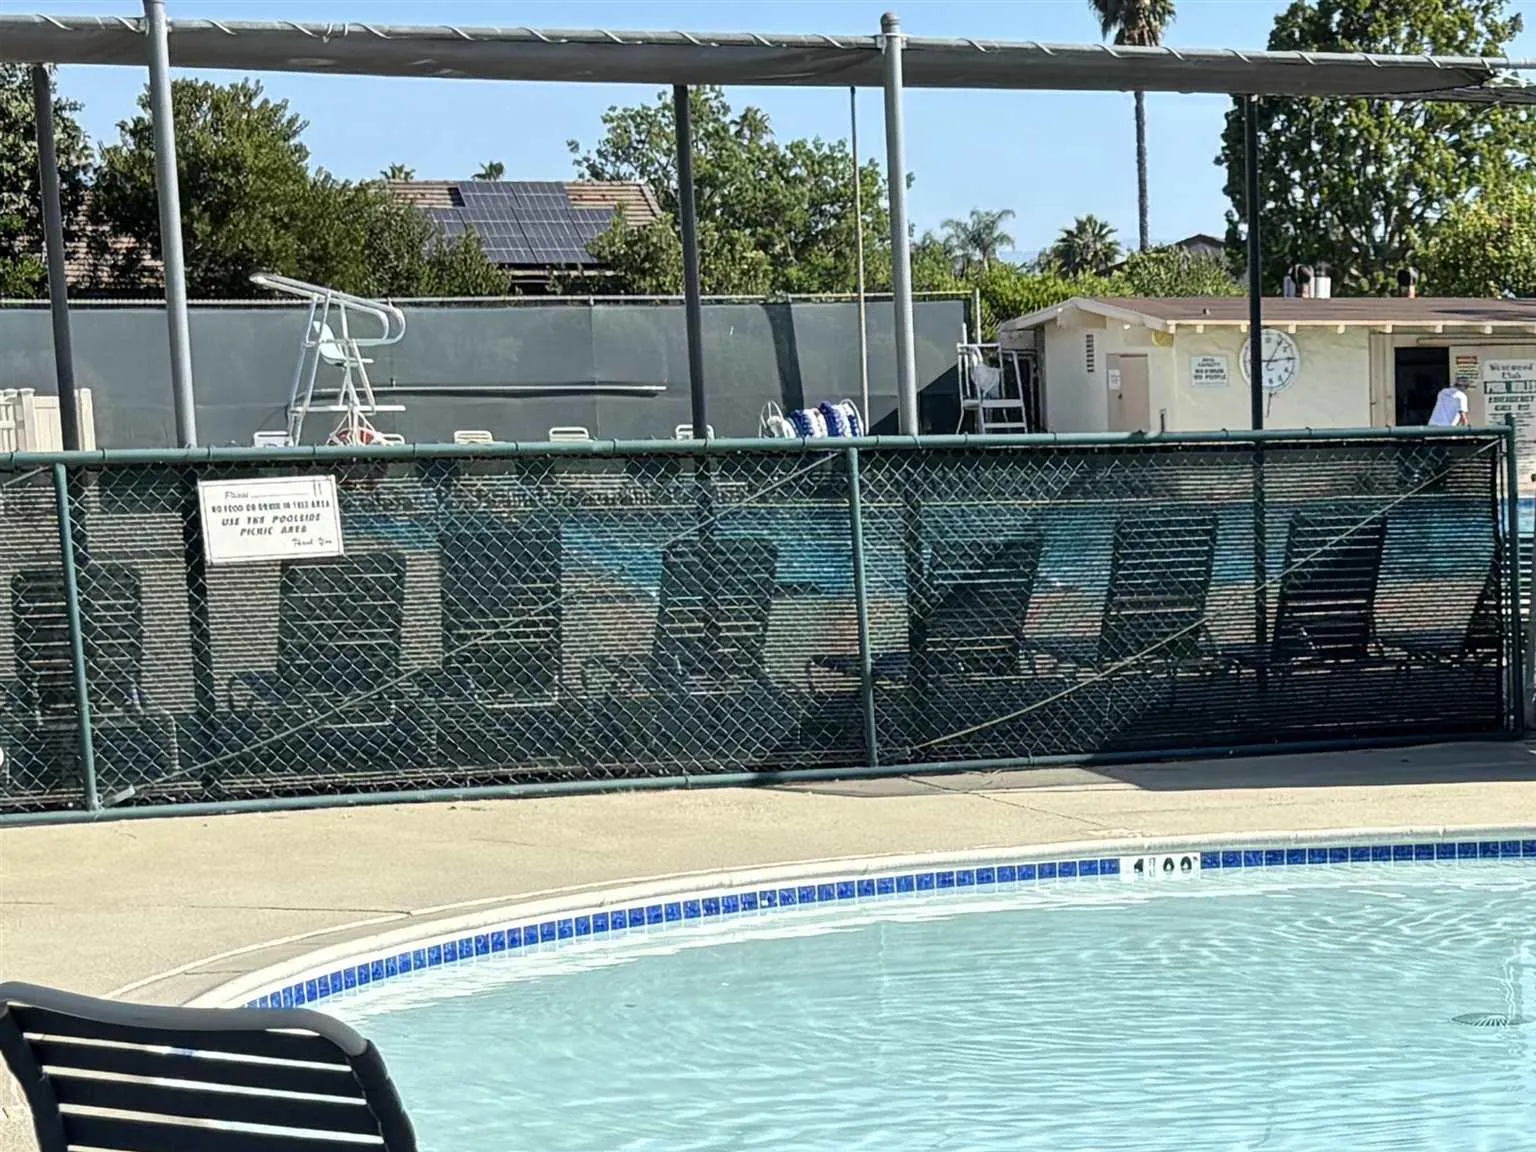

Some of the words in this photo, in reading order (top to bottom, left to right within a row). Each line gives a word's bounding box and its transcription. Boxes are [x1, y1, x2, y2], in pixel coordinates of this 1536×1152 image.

[221, 517, 240, 527] USE
[247, 515, 265, 525] THE
[272, 513, 321, 524] POOLSIDE
[240, 526, 274, 537] PICNIC
[281, 525, 308, 535] AREA
